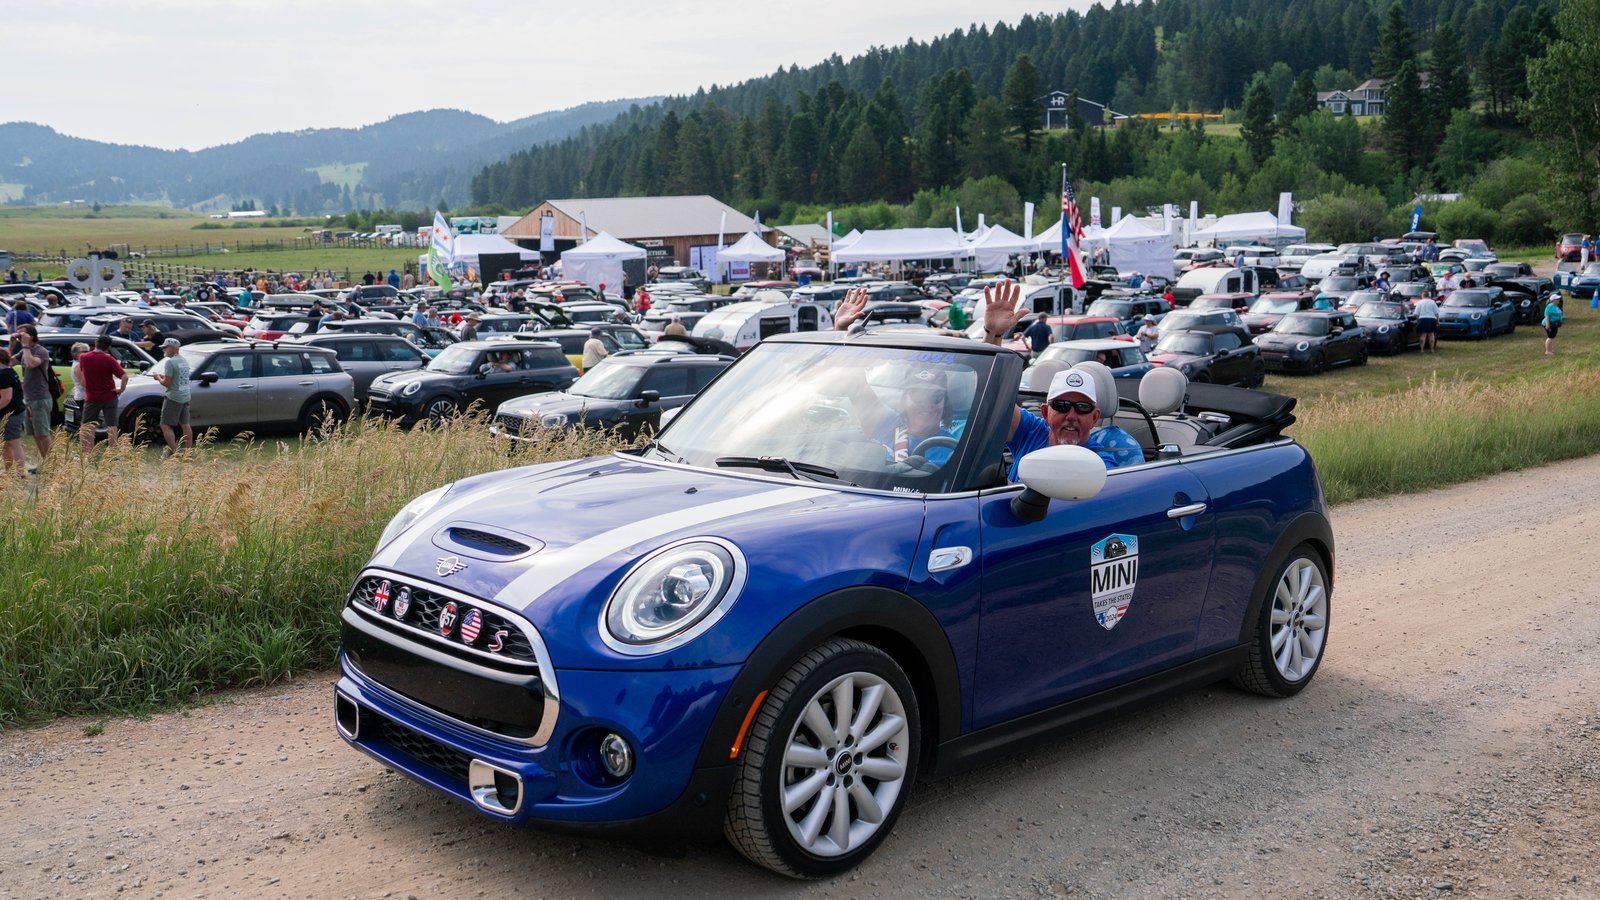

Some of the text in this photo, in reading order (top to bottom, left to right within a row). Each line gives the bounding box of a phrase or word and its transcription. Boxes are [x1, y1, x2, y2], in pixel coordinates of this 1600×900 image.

[1050, 96, 1065, 106] HR
[1092, 559, 1137, 594] MINI
[1094, 592, 1132, 608] TAKES THE STATES
[444, 612, 456, 627] 57
[487, 630, 508, 652] S
[839, 757, 852, 770] MINI
